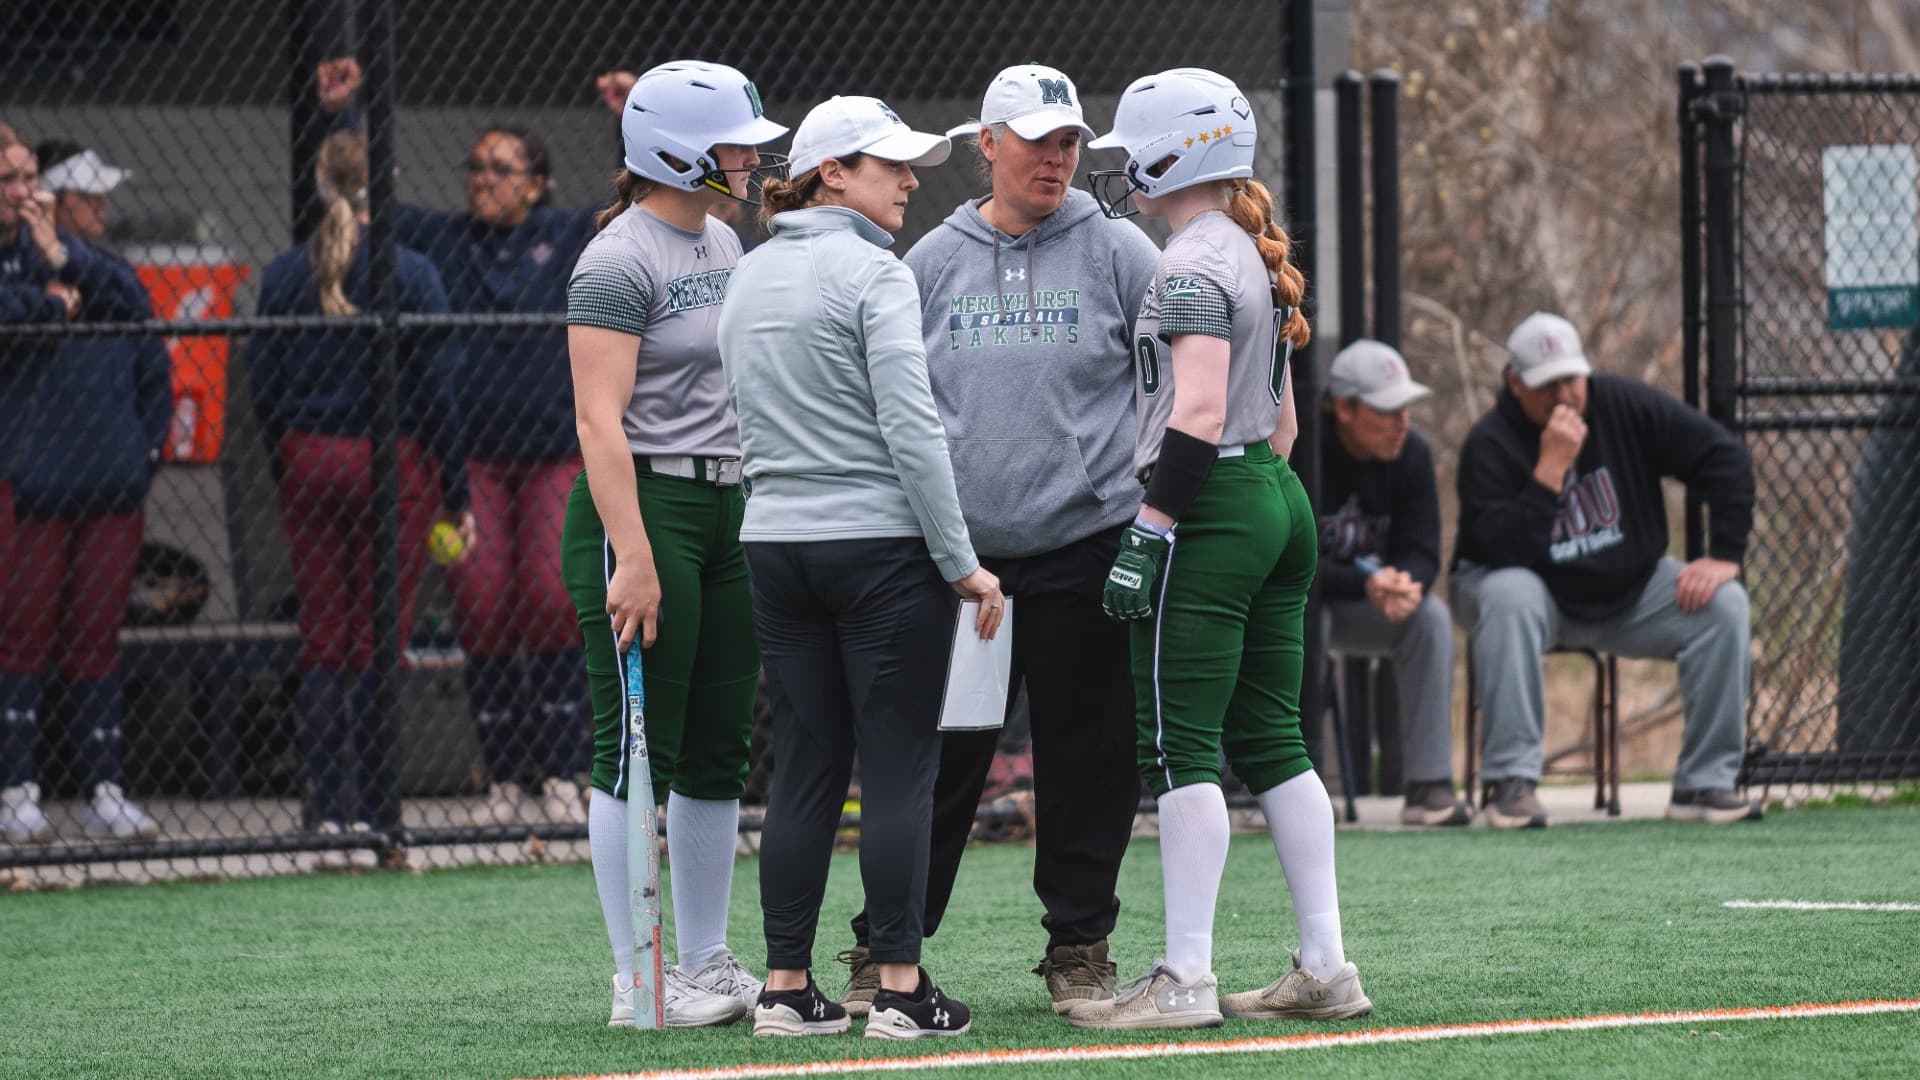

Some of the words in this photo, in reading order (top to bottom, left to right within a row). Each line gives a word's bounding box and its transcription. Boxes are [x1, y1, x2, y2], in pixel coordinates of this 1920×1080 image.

[1038, 79, 1073, 107] M
[667, 268, 735, 313] MERCYH
[1166, 277, 1201, 293] NEC
[950, 289, 1080, 314] MERCYHURST
[951, 325, 1080, 351] LAKERS
